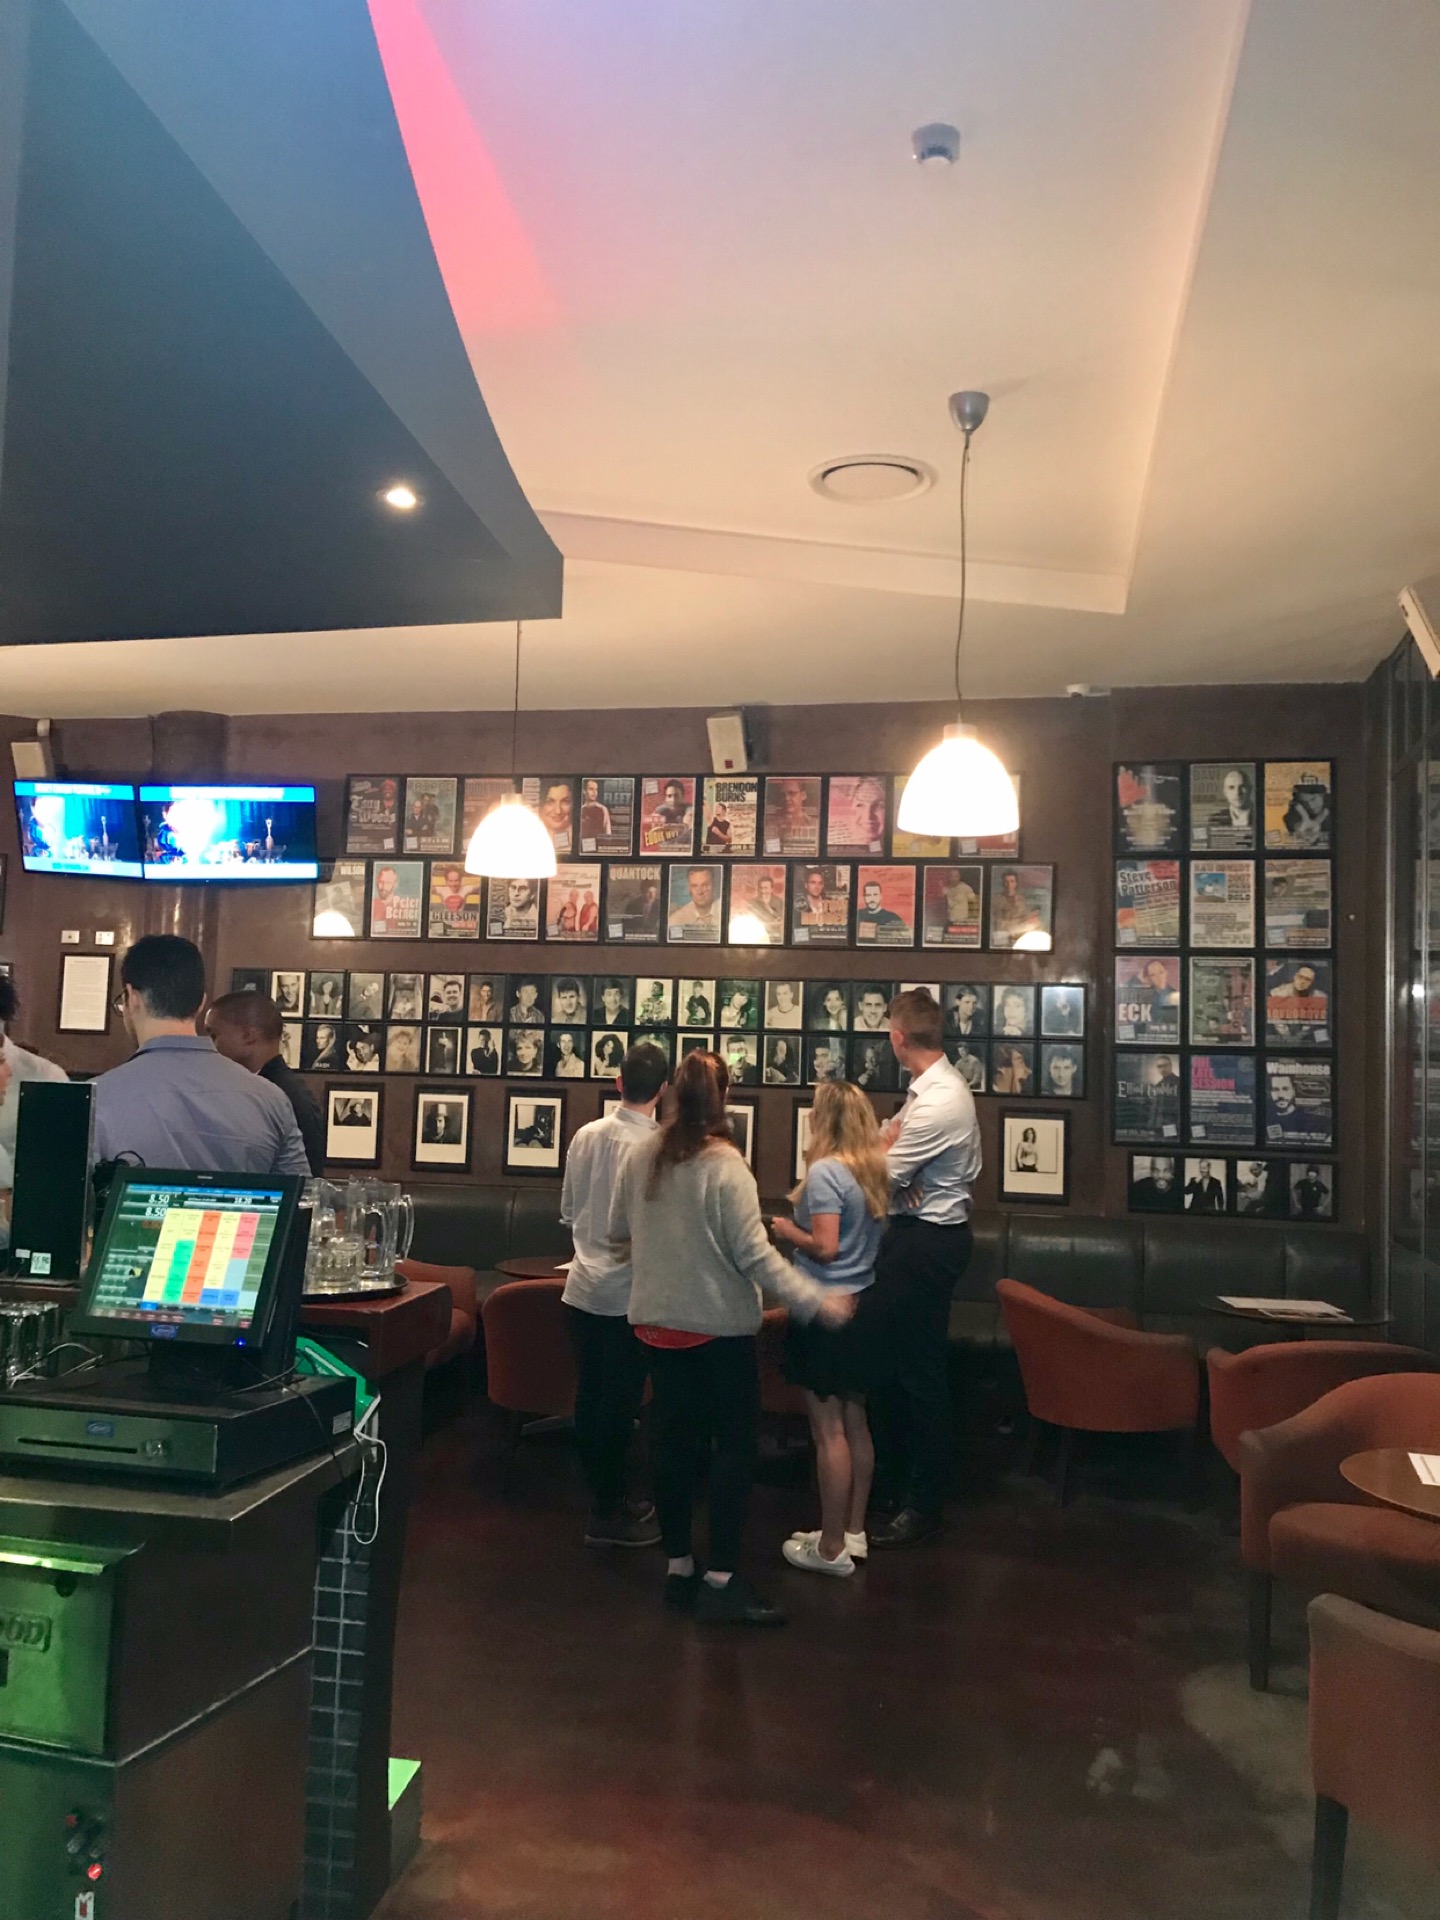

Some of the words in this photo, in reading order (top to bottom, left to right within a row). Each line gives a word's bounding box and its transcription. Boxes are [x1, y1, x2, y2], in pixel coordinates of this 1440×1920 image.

[715, 782, 758, 792] BRENDON
[603, 793, 632, 804] FLEET
[715, 792, 746, 803] BURNS
[609, 866, 661, 881] QUANTOCK
[1119, 871, 1152, 884] Steve
[1120, 880, 1177, 897] Patterson
[392, 895, 419, 909] Peter
[431, 910, 478, 921] GLEESON
[1118, 1003, 1152, 1022] ECK
[149, 1194, 169, 1203] 8.50
[145, 1207, 167, 1217] 8.50
